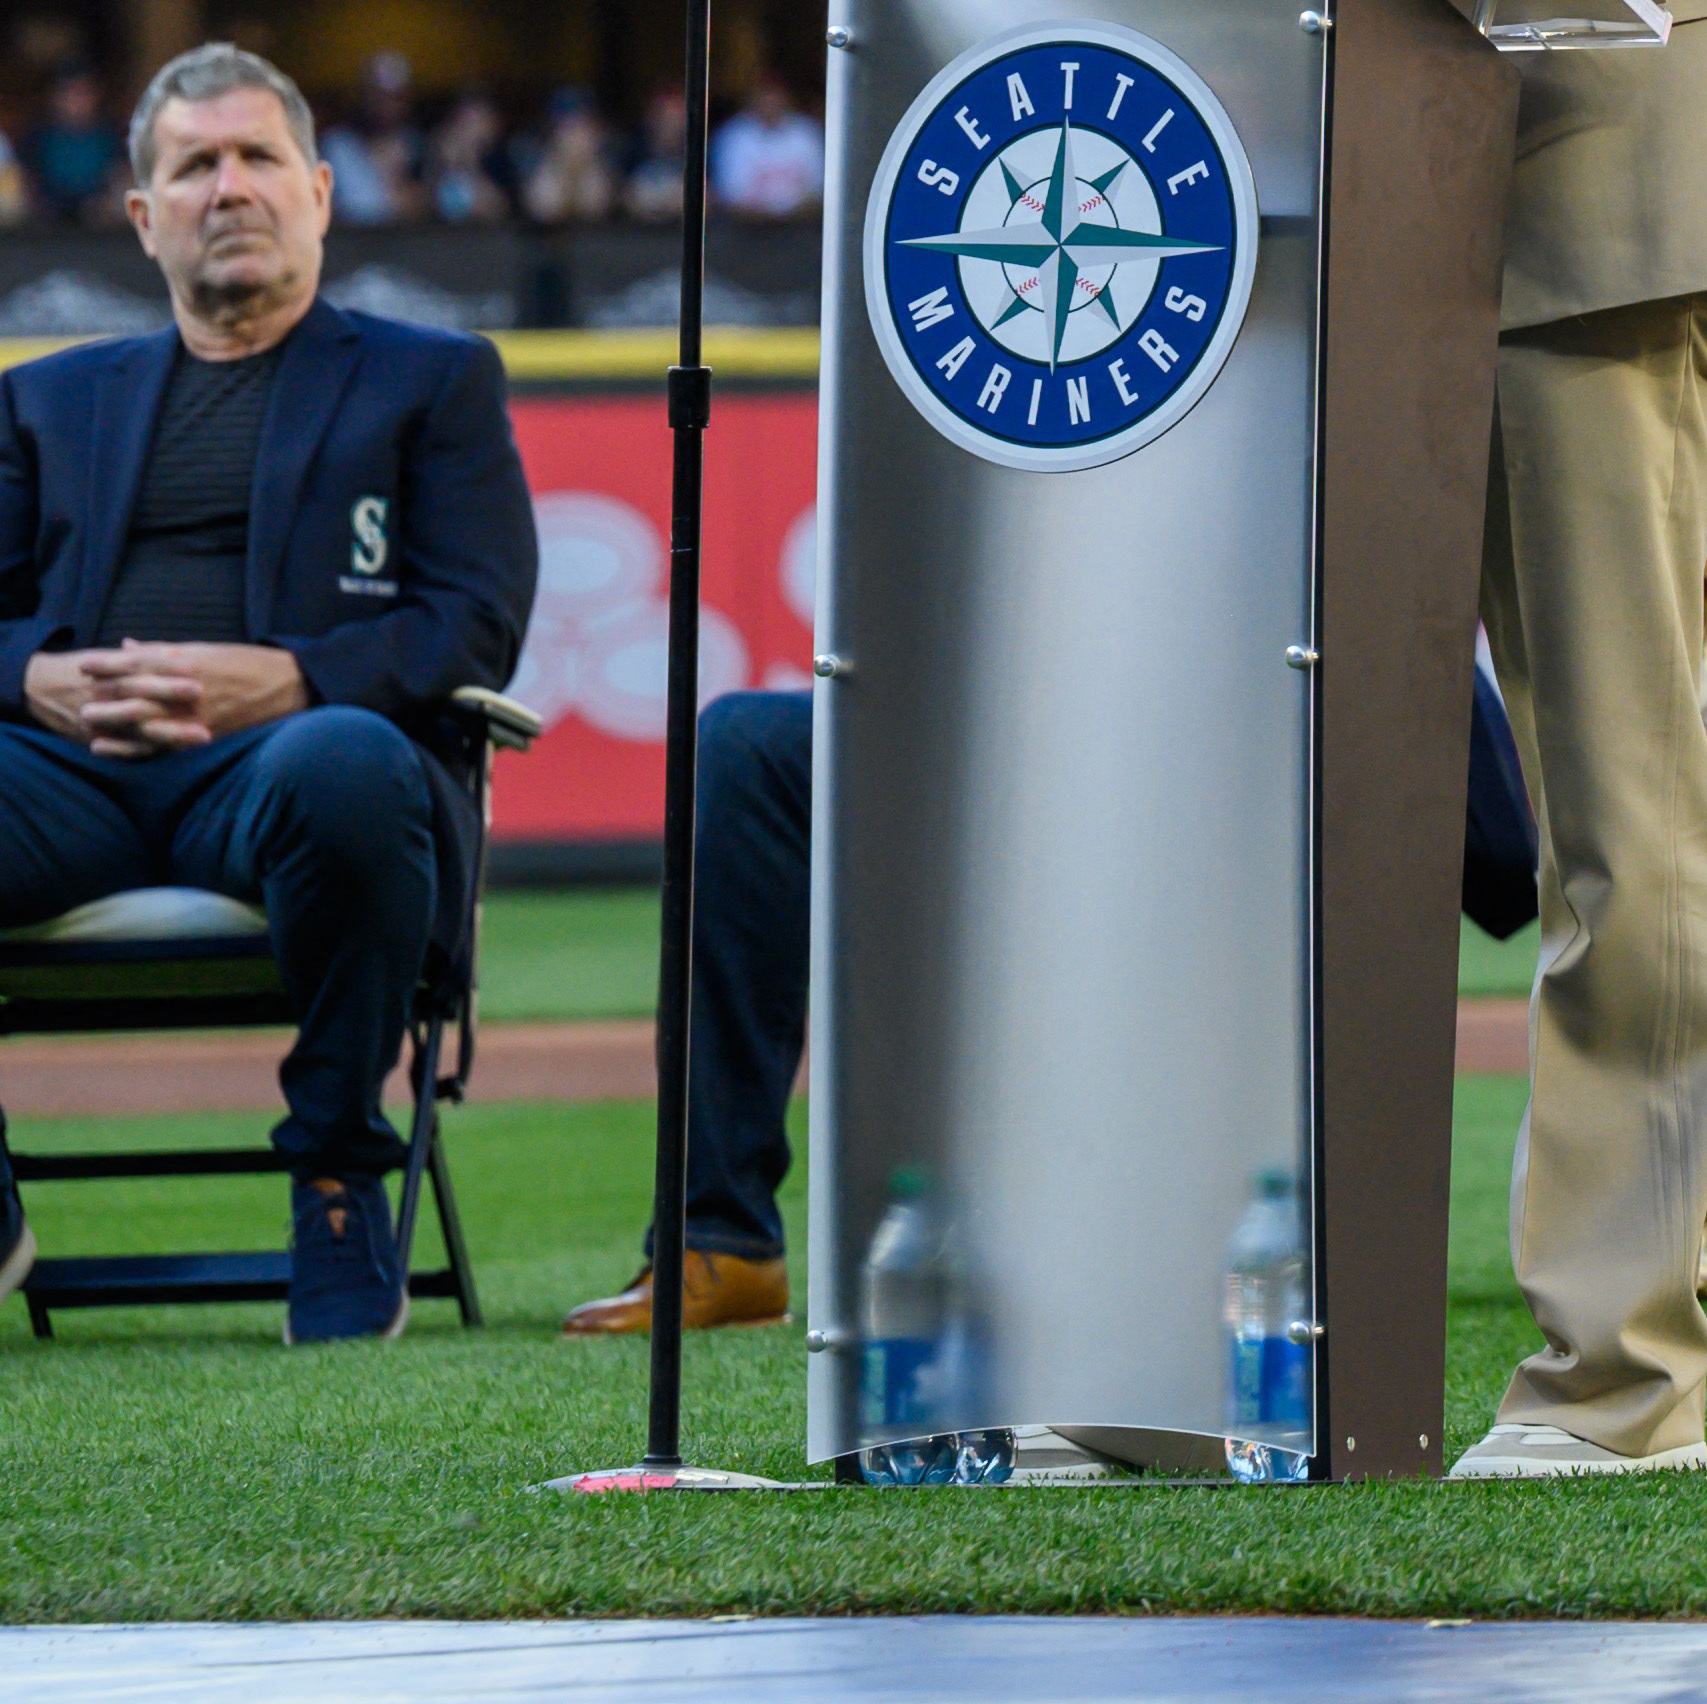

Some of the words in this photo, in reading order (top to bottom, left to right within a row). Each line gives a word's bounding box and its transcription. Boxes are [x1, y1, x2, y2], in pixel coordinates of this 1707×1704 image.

[916, 60, 1210, 197] SEATTLE
[907, 285, 1207, 427] MARINERS
[350, 495, 389, 575] S
